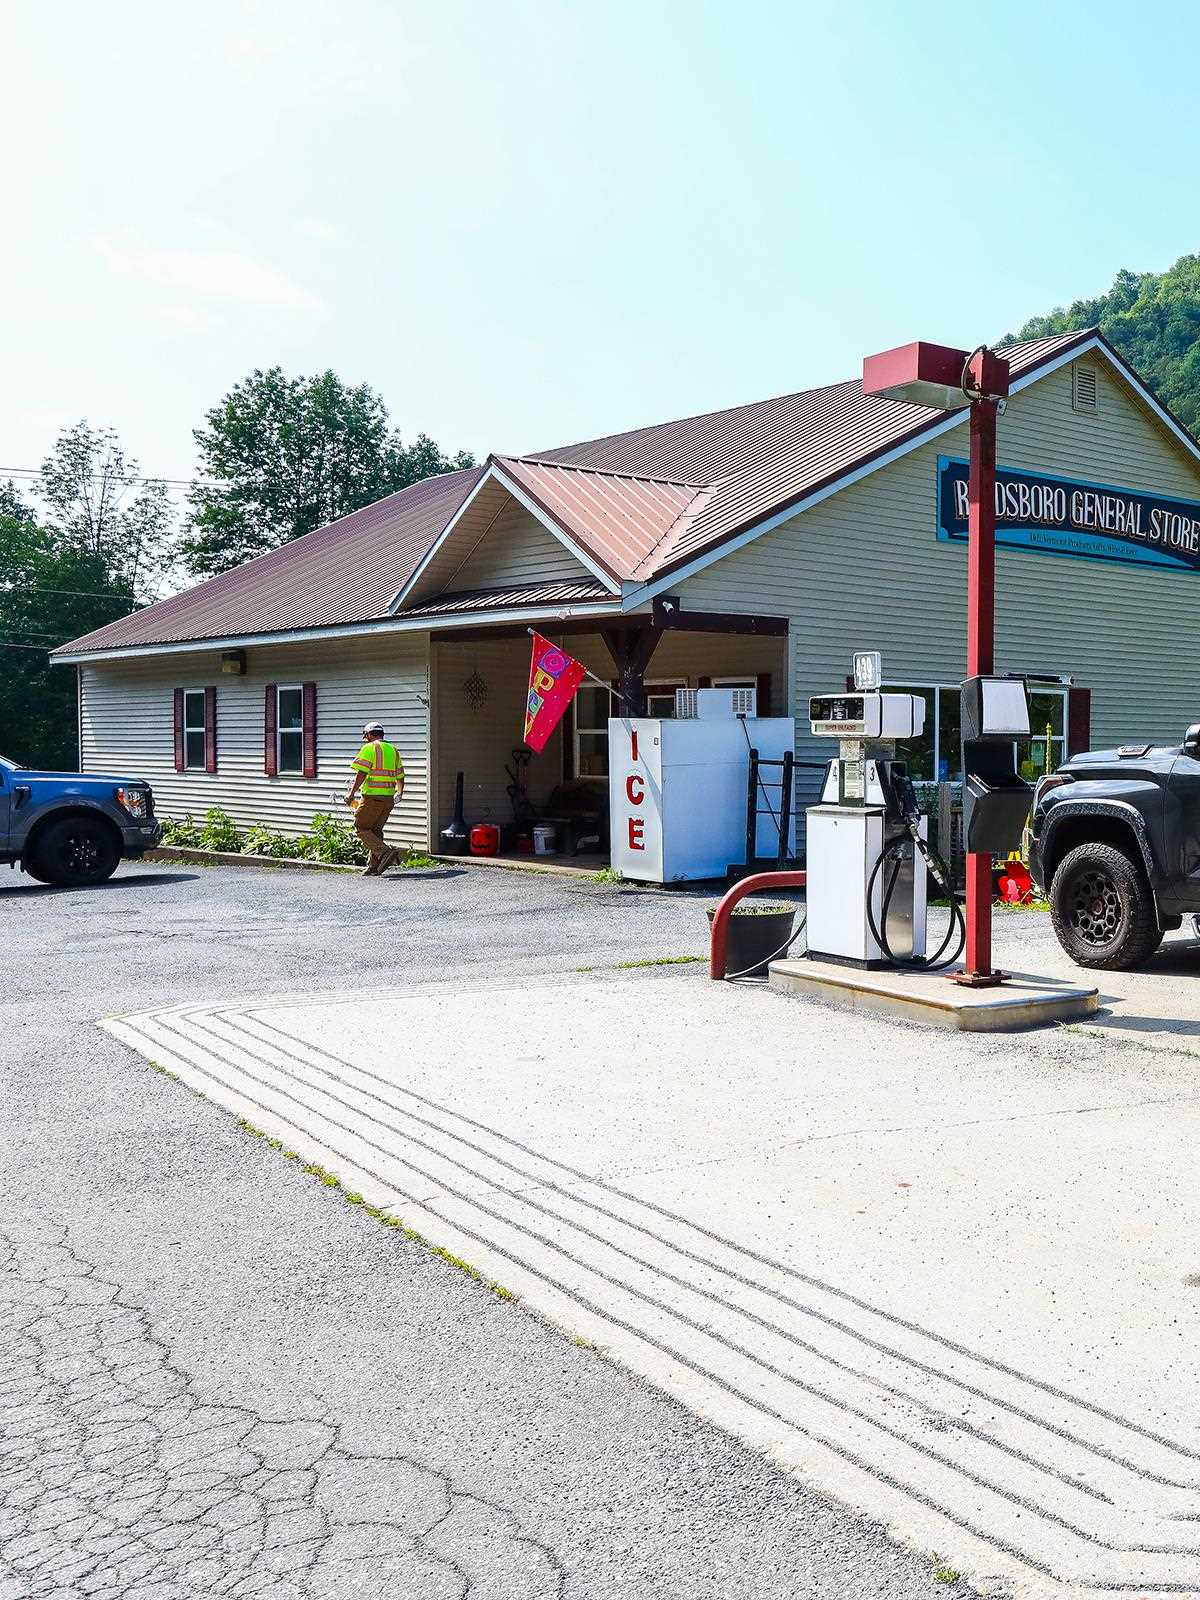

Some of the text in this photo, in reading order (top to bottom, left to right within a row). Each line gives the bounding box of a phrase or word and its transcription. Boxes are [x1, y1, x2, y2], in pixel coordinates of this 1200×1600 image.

[955, 479, 1200, 553] RDSBORO GENERAL STORE
[625, 727, 645, 850] ICE
[869, 766, 875, 782] 3
